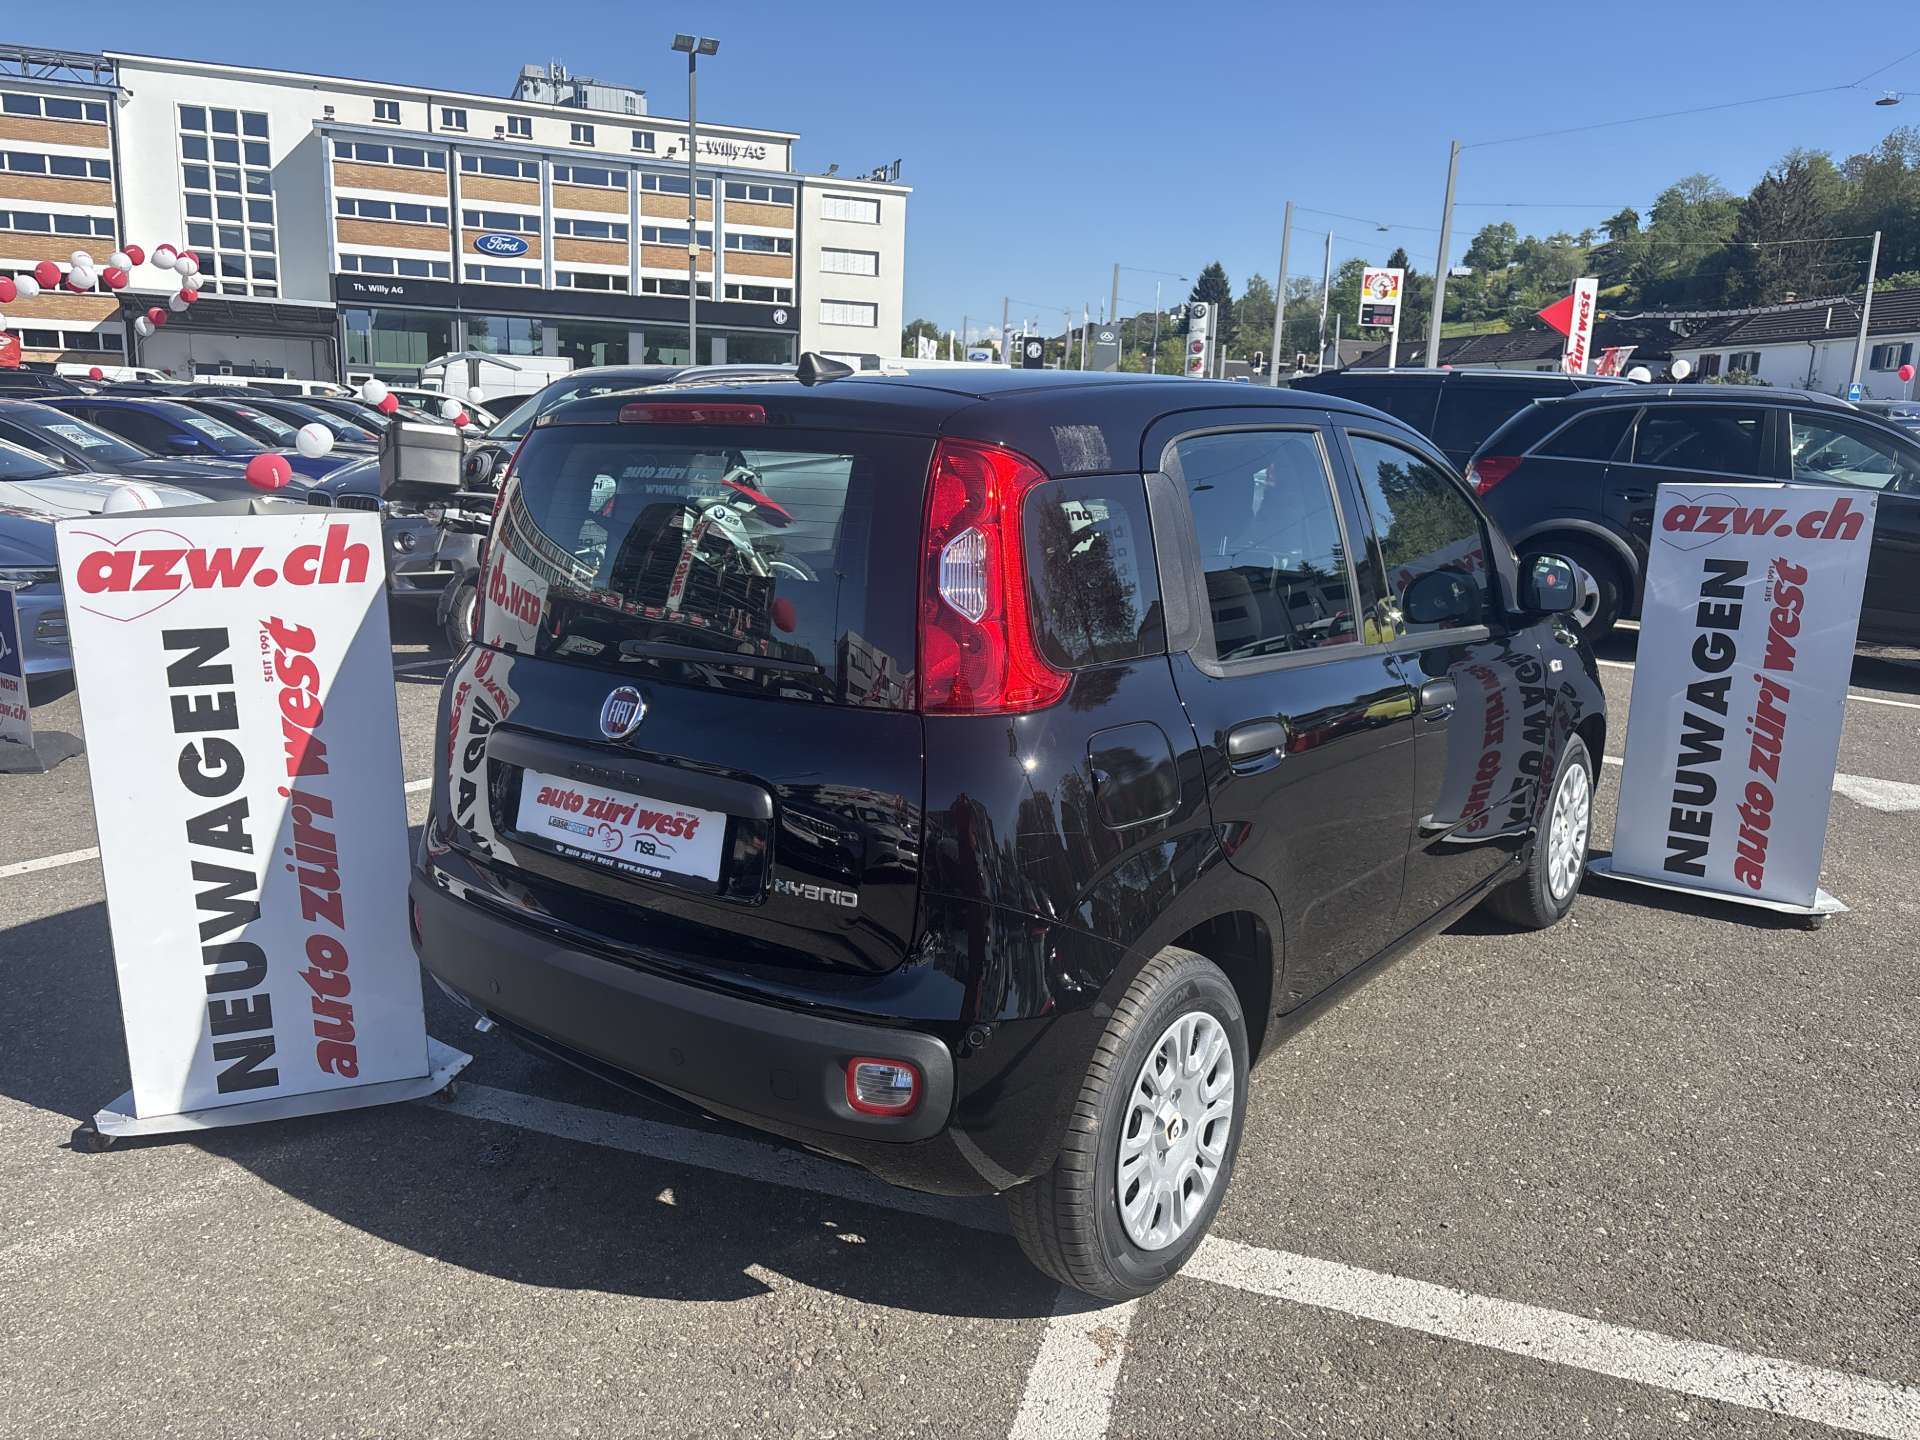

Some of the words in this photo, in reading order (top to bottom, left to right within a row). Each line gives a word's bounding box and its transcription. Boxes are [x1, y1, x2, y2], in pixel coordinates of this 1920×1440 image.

[706, 140, 740, 160] Willy
[742, 144, 768, 160] AG
[486, 235, 519, 252] Ford
[353, 283, 366, 292] Th.
[368, 283, 389, 295] Willy
[391, 286, 404, 294] AG
[1577, 290, 1591, 332] west
[1027, 343, 1041, 358] MG
[1662, 497, 1865, 541] azw.ch
[76, 523, 371, 594] azw.ch
[1763, 556, 1809, 672] west
[259, 629, 272, 658] 1991
[263, 659, 274, 683] SEIT
[258, 615, 330, 778] west
[607, 700, 636, 725] FIAT
[1663, 558, 1749, 878] NEUWAGEN
[1744, 673, 1791, 784] züri
[536, 785, 584, 813] auto
[582, 796, 639, 826] züri
[636, 809, 701, 840] west
[564, 847, 580, 858] auto
[597, 855, 614, 867] west
[634, 839, 657, 856] nsa
[1733, 780, 1775, 891] auto
[160, 626, 280, 1095] NEUWAGEN
[276, 785, 346, 930] züri
[774, 878, 858, 908] HYBRID
[298, 934, 360, 1079] auto
